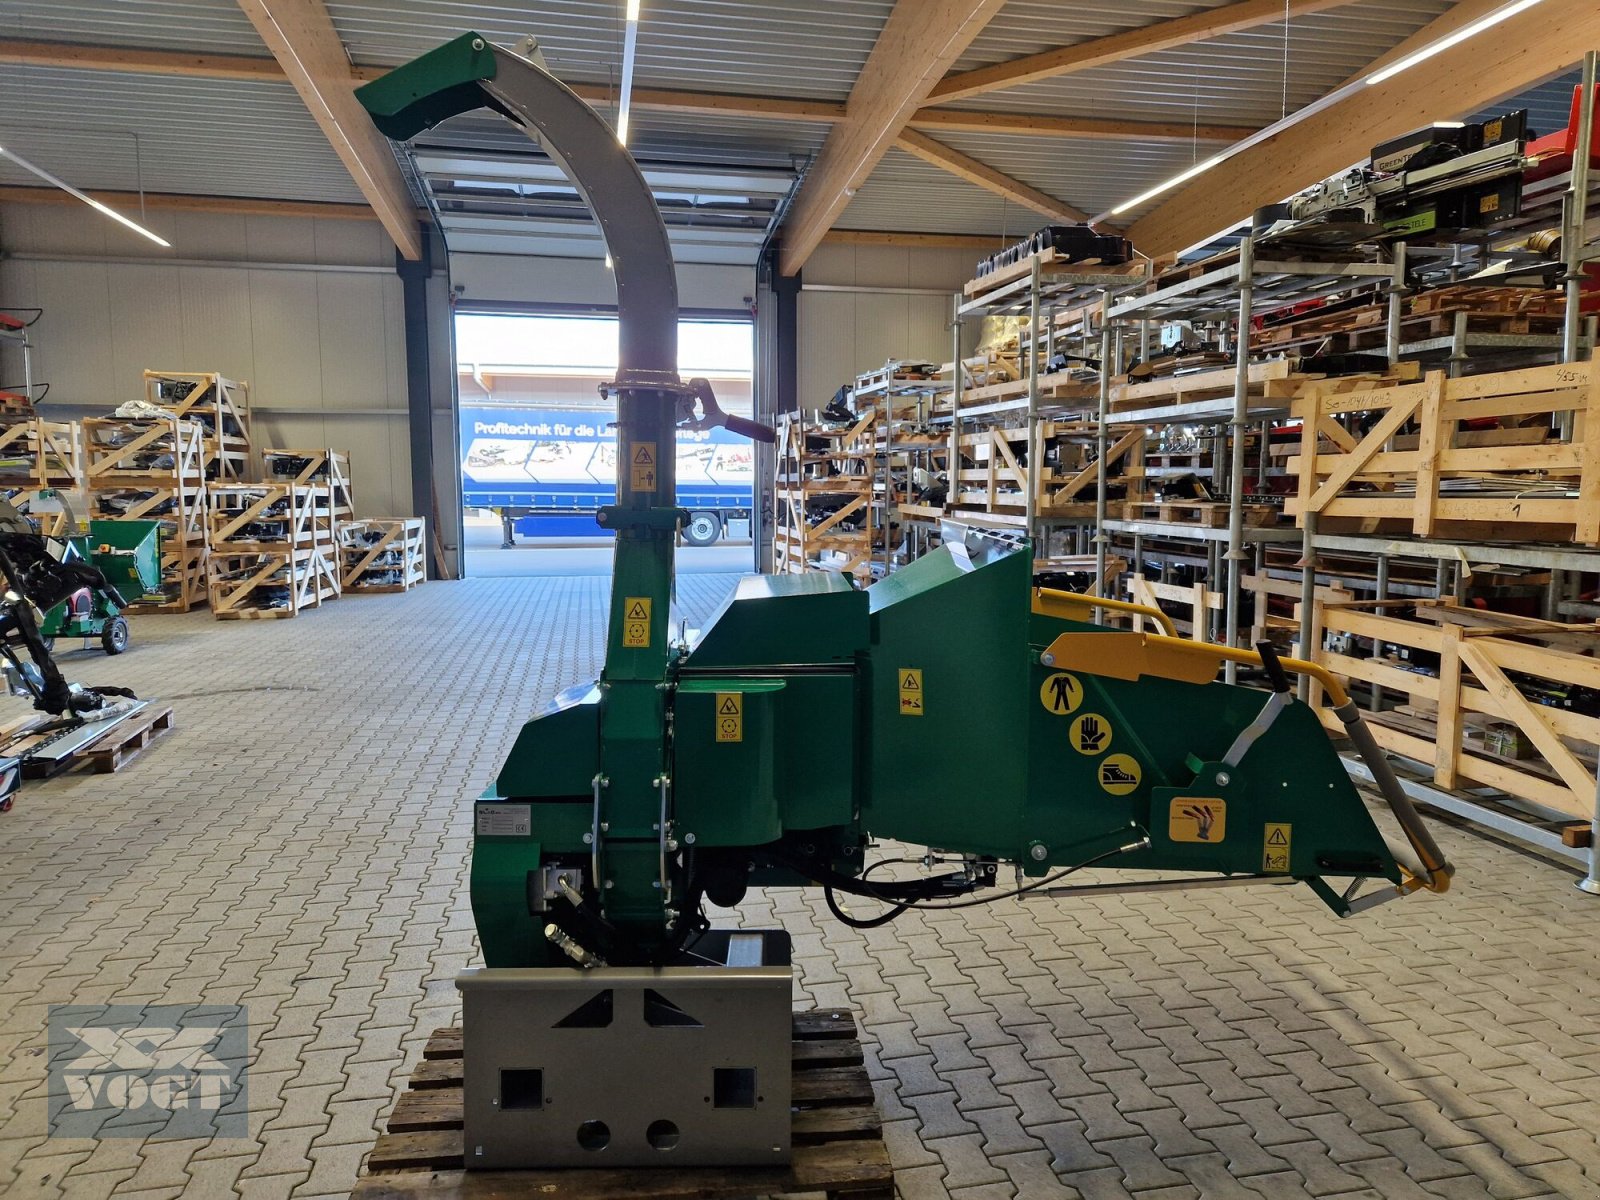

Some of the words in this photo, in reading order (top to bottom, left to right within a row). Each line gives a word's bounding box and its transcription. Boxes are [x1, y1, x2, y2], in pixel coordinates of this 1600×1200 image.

[474, 421, 552, 436] Profitechnik
[554, 423, 573, 437] für
[574, 424, 595, 437] die
